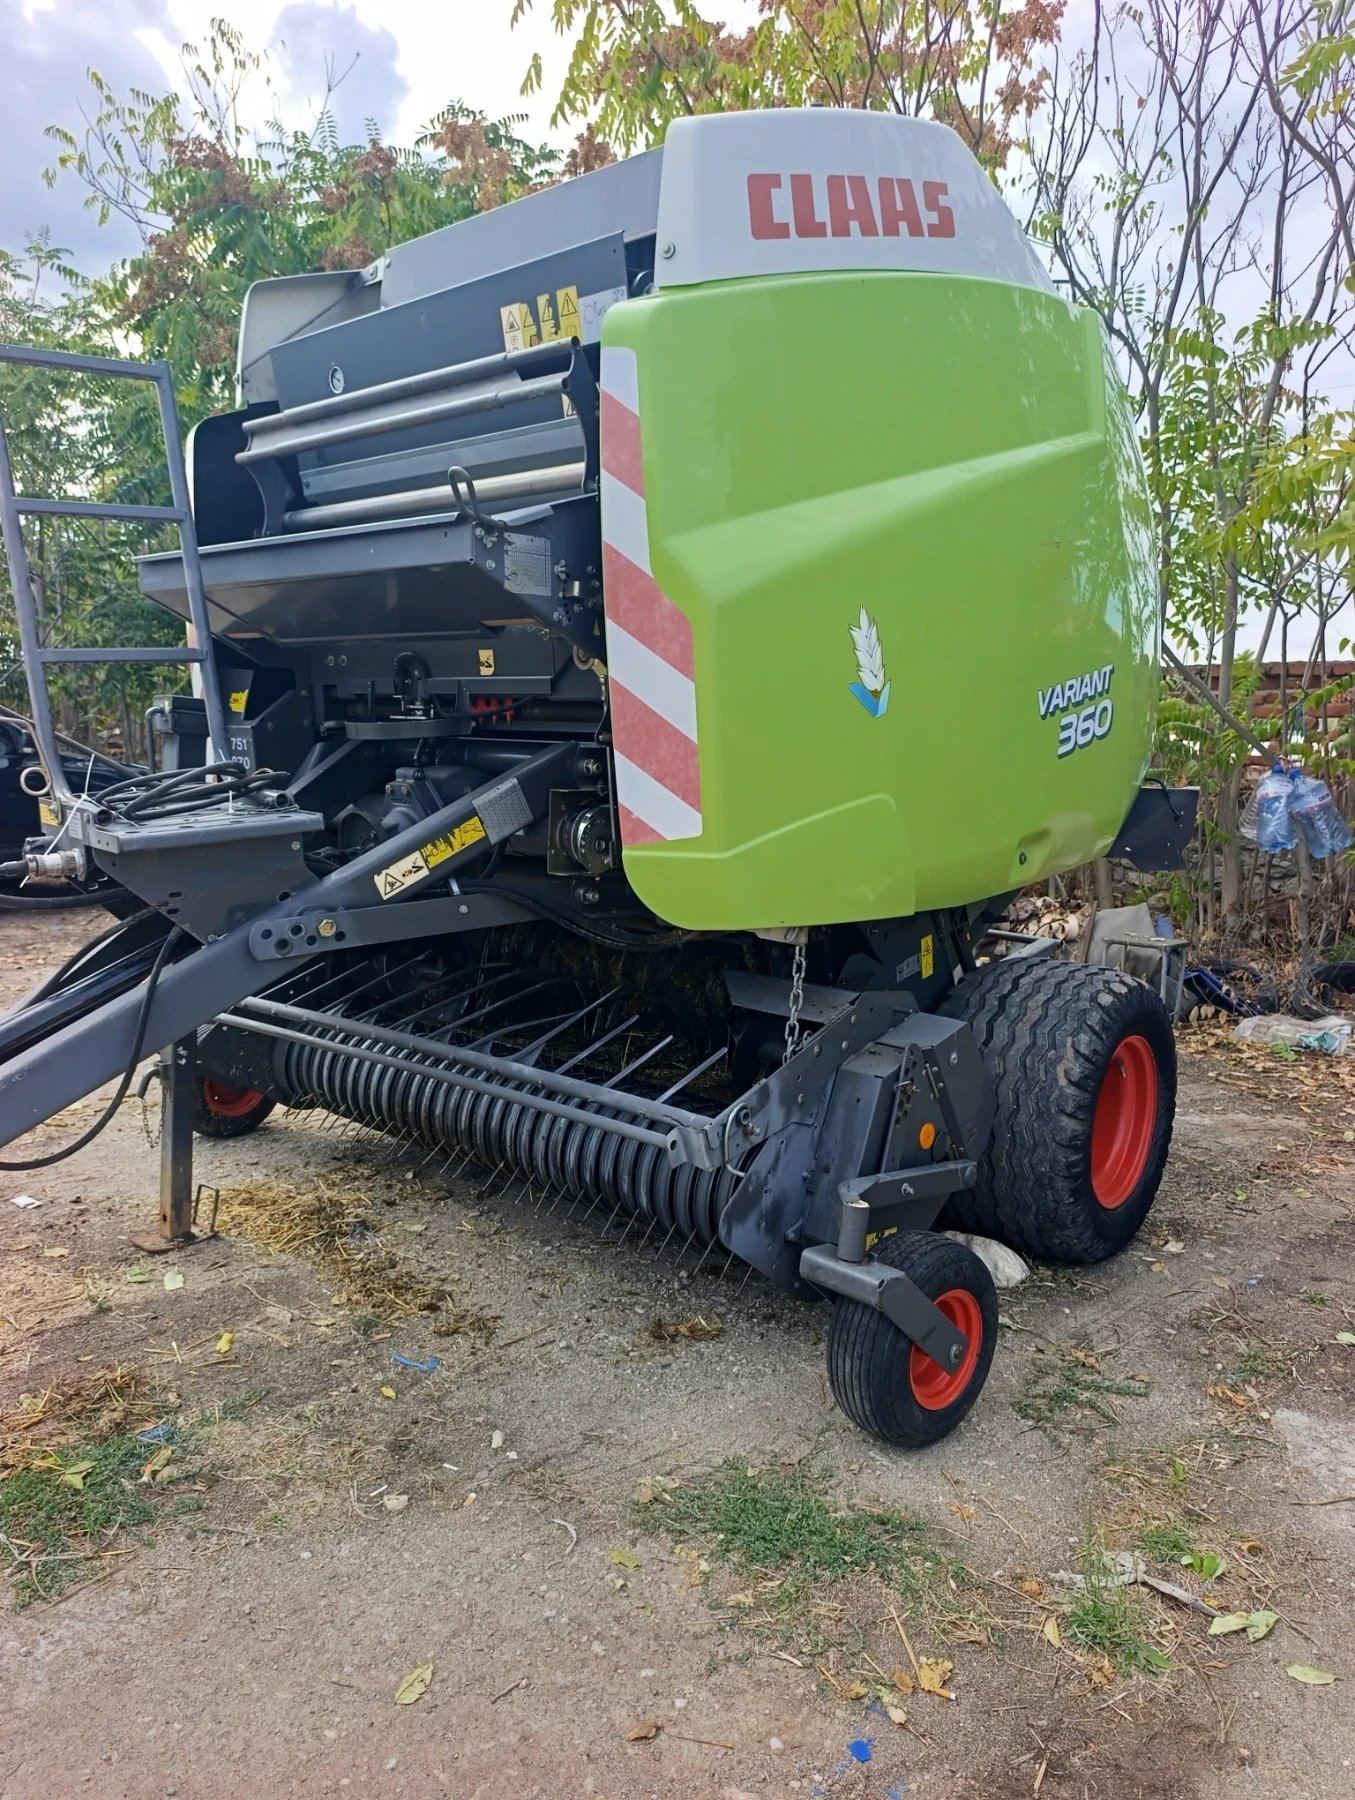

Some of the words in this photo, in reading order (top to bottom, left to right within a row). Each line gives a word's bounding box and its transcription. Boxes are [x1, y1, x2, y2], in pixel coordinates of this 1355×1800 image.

[747, 173, 956, 240] CLAAS
[1038, 663, 1114, 720] VARIANT
[230, 737, 248, 751] 751
[1057, 698, 1113, 760] 360
